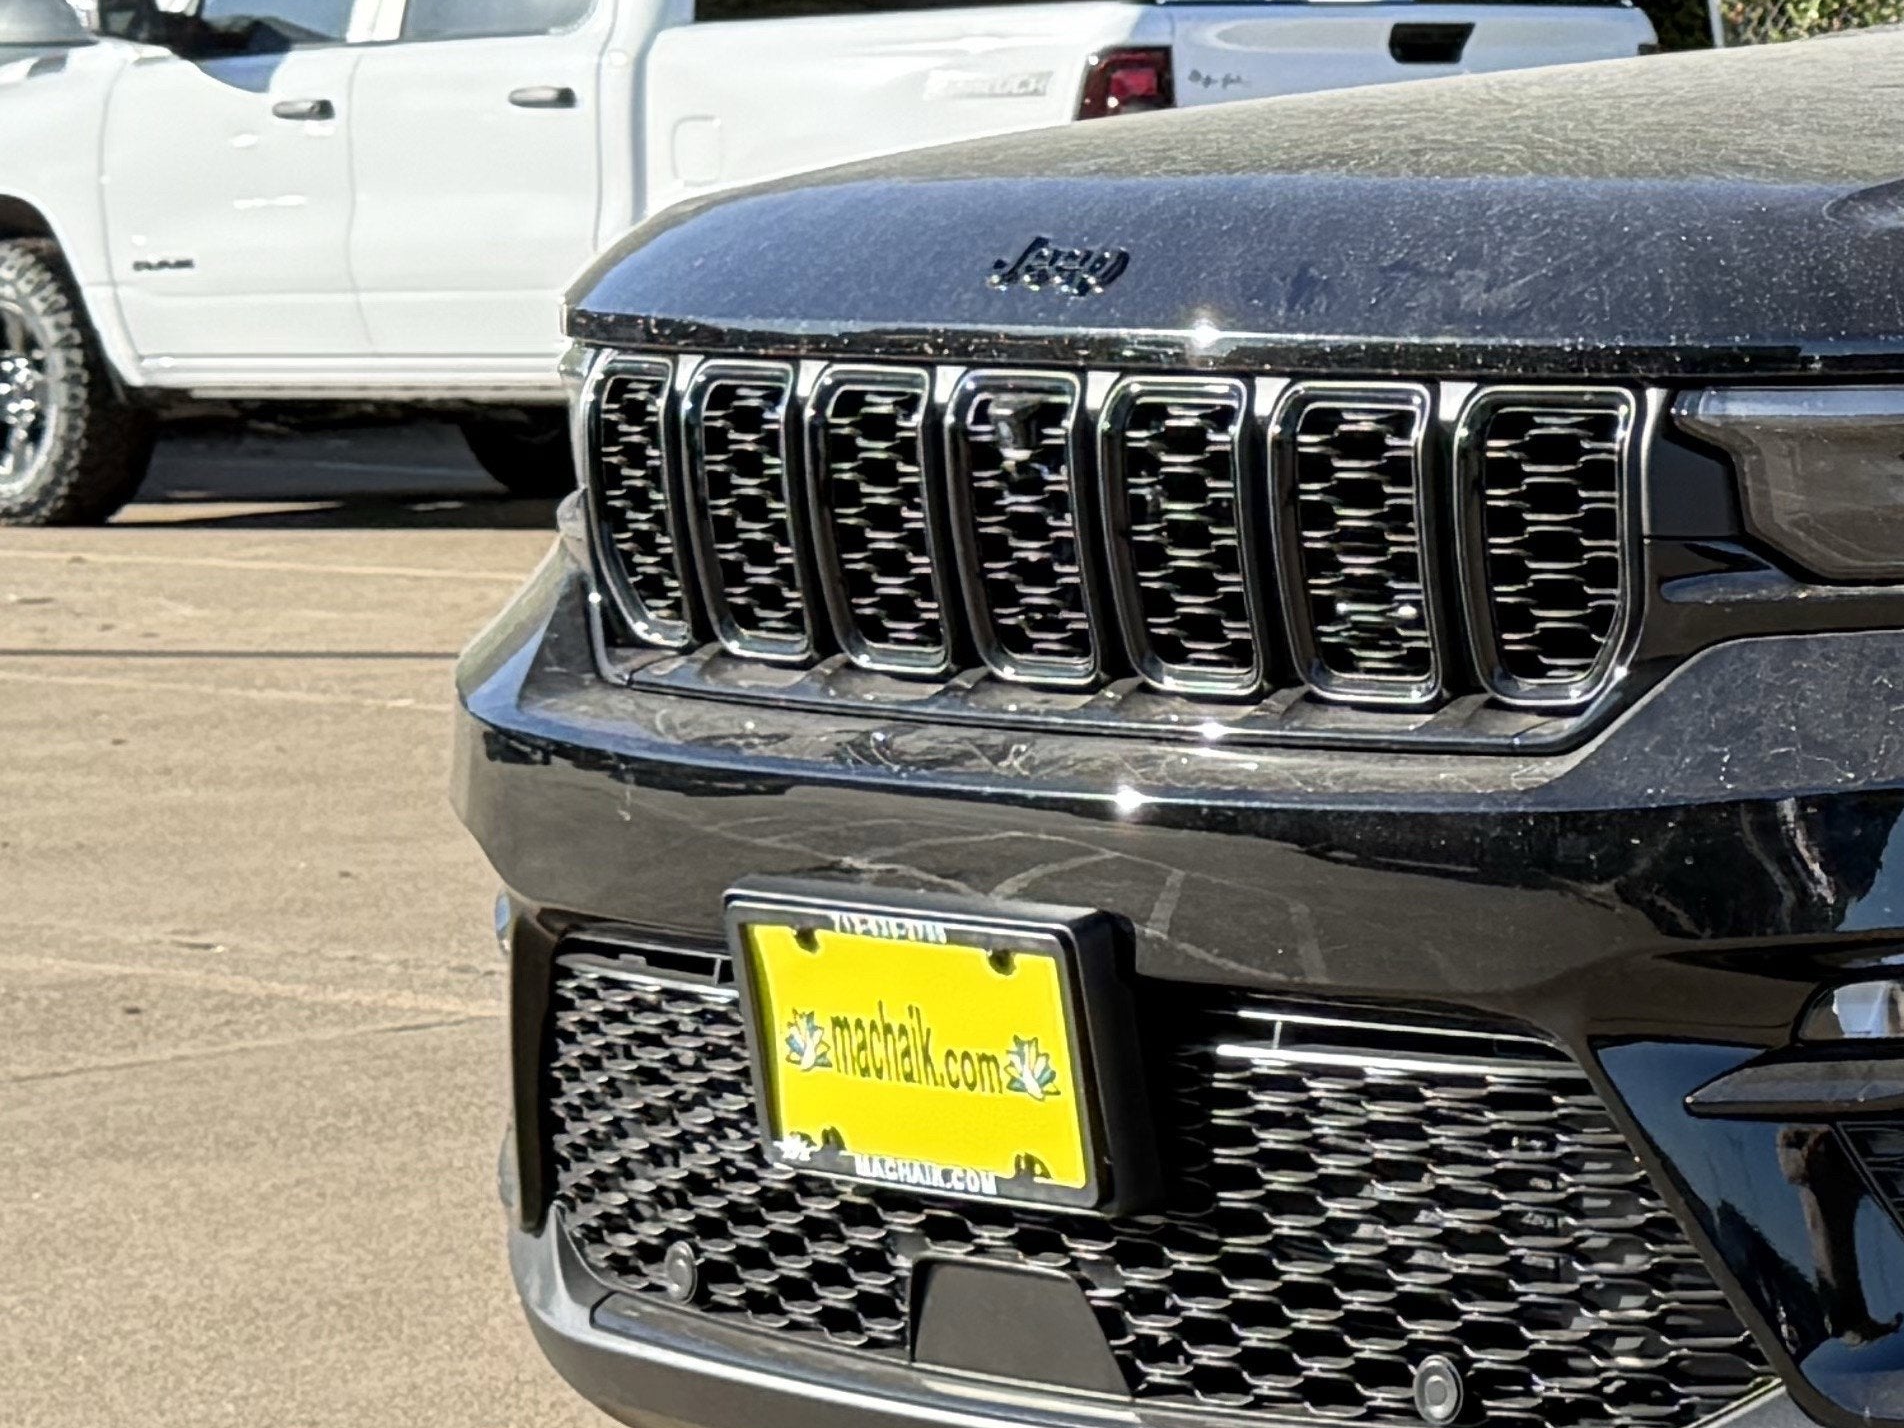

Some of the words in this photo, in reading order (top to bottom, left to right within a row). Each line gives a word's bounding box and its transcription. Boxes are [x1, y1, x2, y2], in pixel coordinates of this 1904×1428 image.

[988, 236, 1131, 298] Jeep
[830, 1001, 1004, 1094] machaik.com
[854, 1154, 997, 1196] MACHAIK.COM
